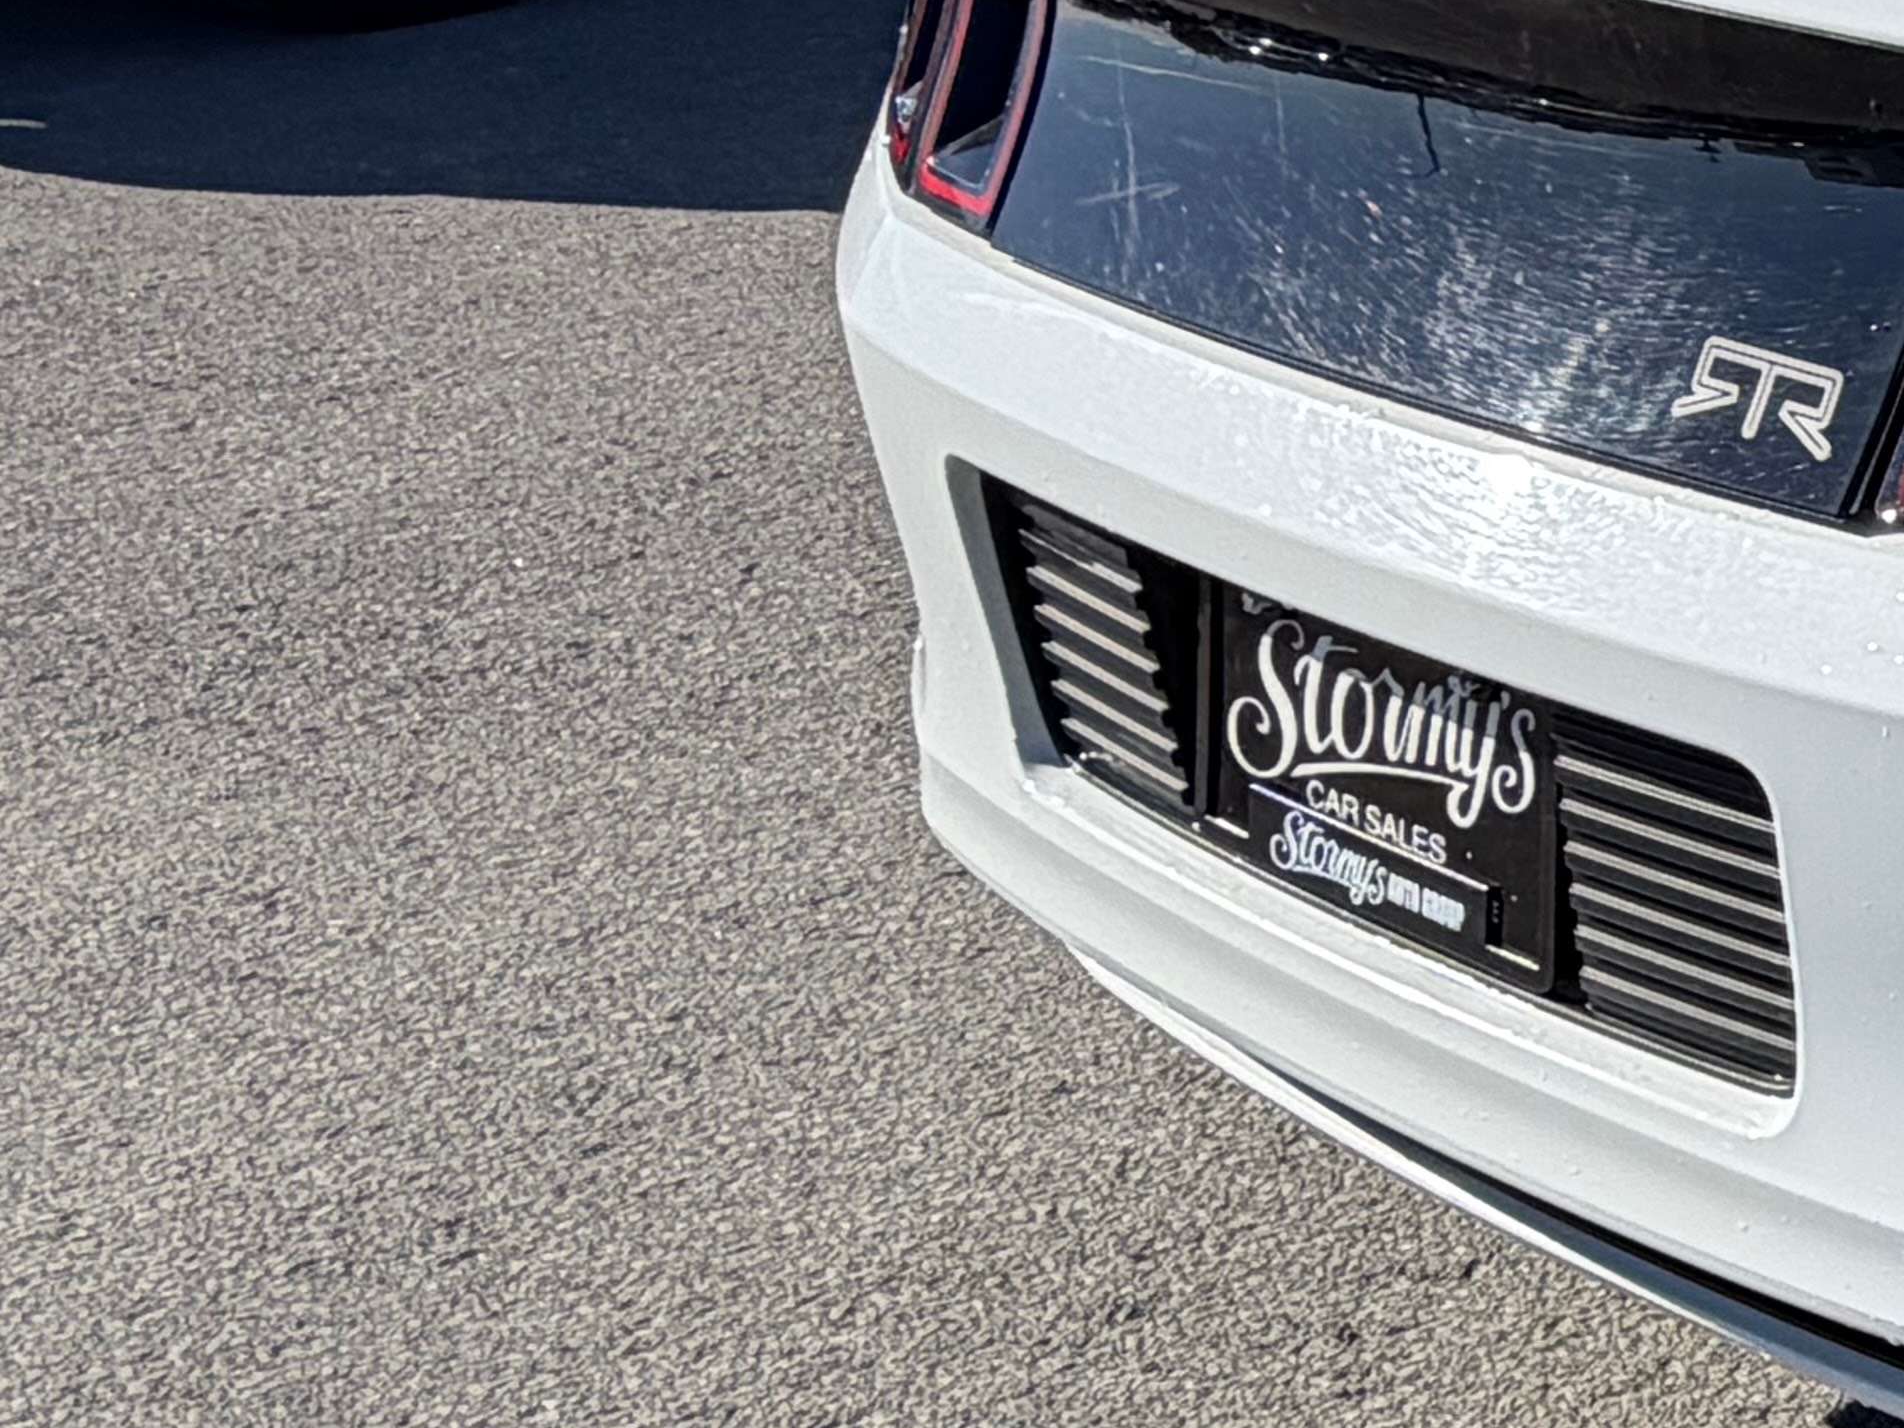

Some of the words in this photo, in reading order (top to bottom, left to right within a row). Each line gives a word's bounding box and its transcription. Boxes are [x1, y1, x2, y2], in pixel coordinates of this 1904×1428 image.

[1671, 335, 1844, 461] RTR
[1227, 619, 1536, 829] Stormy's
[1269, 810, 1388, 906] Stormy's
[1306, 779, 1359, 827] CAR
[1363, 803, 1448, 865] SALES
